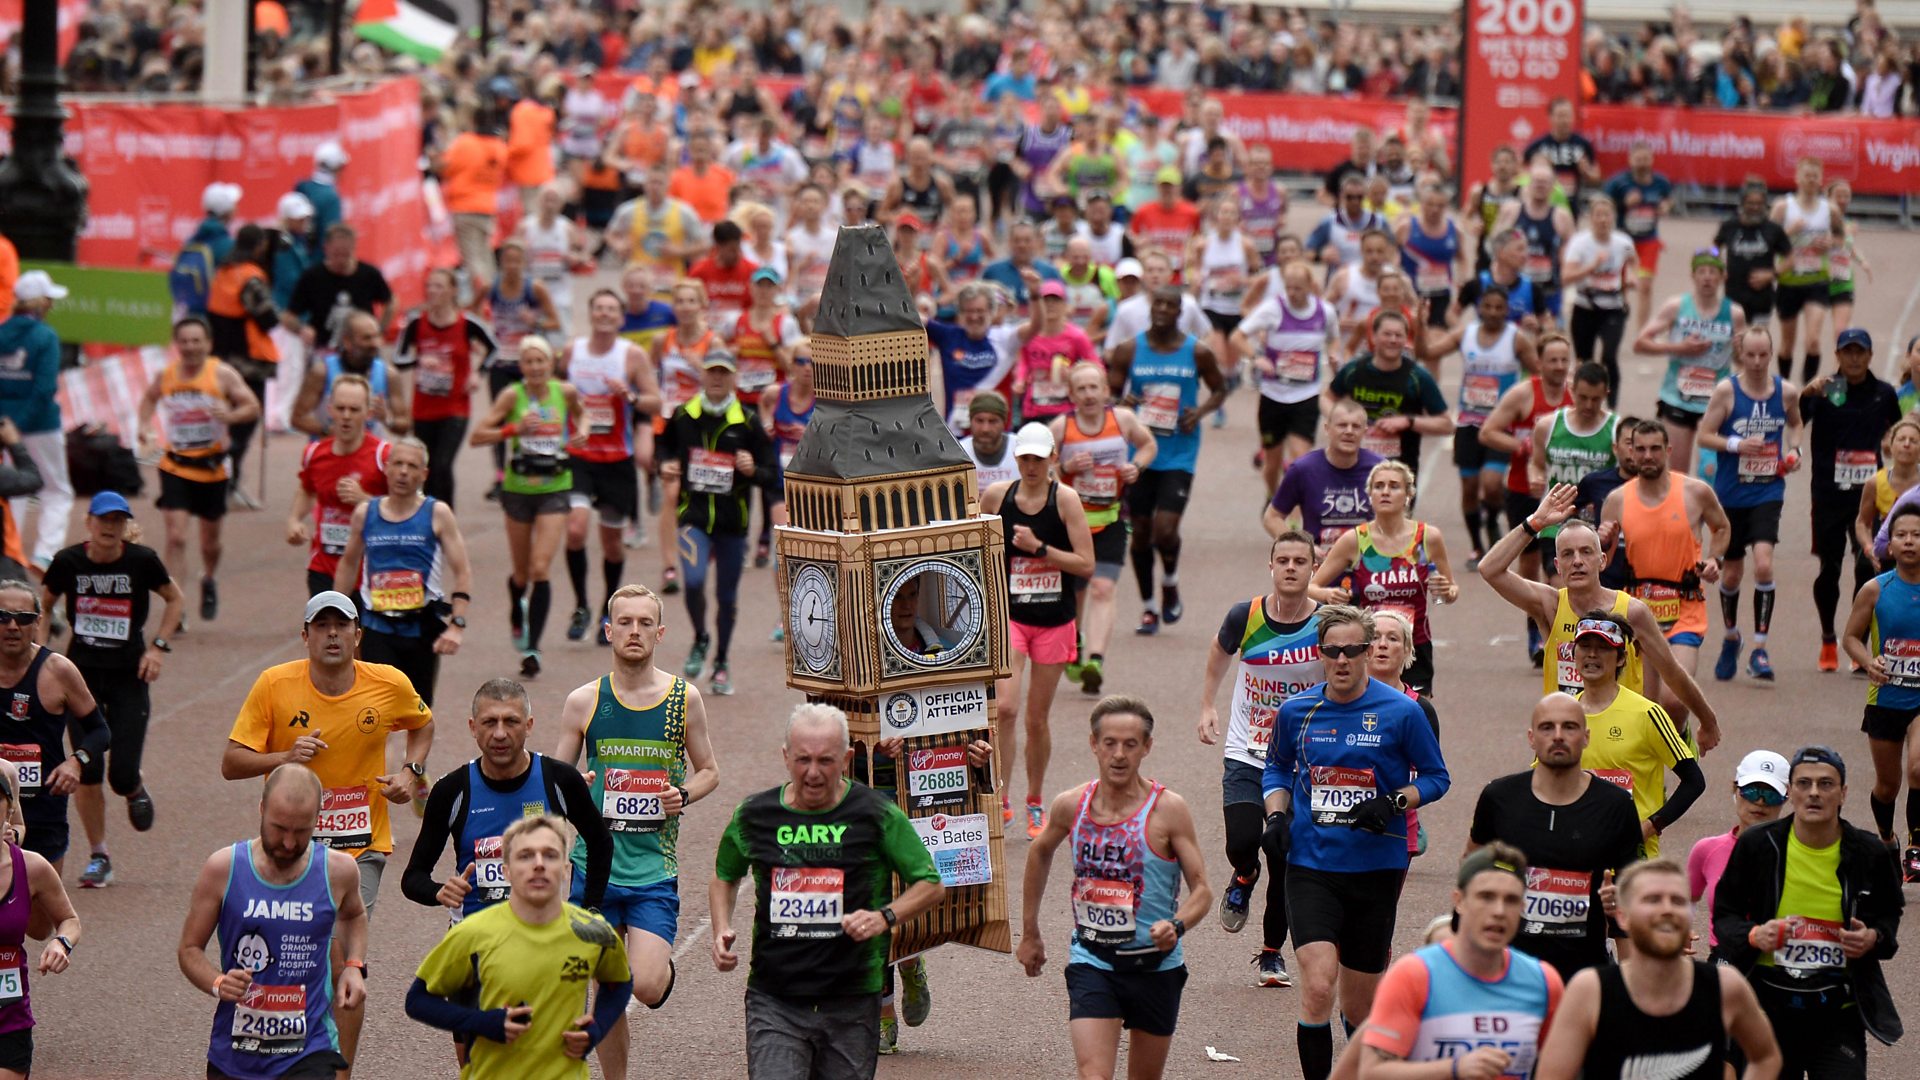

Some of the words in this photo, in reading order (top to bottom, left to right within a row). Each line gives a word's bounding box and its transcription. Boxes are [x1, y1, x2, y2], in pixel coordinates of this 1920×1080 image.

[1475, 0, 1575, 35] 200
[1489, 58, 1520, 79] TO
[1523, 59, 1560, 80] GO
[1267, 114, 1353, 144] Maratho
[1669, 128, 1766, 160] Marathon
[1353, 386, 1403, 408] Harry
[1751, 401, 1771, 419] AL
[977, 469, 1011, 479] WISTY
[76, 574, 132, 594] PWR
[1016, 574, 1060, 590] 34707
[1370, 569, 1419, 585] CIARA
[1365, 586, 1417, 598] mencap
[1650, 602, 1679, 618] 909
[82, 616, 126, 636] 28516
[1268, 645, 1317, 665] PAUL
[1244, 671, 1315, 695] RAINBOW
[925, 689, 982, 706] OFFICIAL
[926, 701, 983, 719] ATTEMPT
[1356, 733, 1382, 743] TJALVE
[600, 745, 673, 759] SAMARITANS
[935, 751, 964, 761] money
[633, 777, 665, 787] money
[918, 770, 965, 791] 26885
[1339, 773, 1372, 783] money
[335, 791, 366, 802] money
[616, 796, 660, 816] 6823
[314, 811, 368, 832] 44328
[776, 824, 847, 845] GARY
[921, 834, 938, 847] as
[943, 828, 983, 844] Bates
[1081, 842, 1127, 864] ALEX
[803, 875, 841, 887] money
[1552, 876, 1590, 889] money
[1095, 886, 1132, 900] money
[243, 898, 314, 922] JAMES
[779, 898, 838, 918] 23441
[1087, 905, 1128, 927] 6263
[1526, 895, 1588, 919] 70699
[281, 934, 311, 944] GREAT
[1808, 923, 1841, 937] mone
[280, 943, 318, 951] ORMOND
[280, 952, 311, 960] STREET
[1784, 944, 1844, 966] 72363
[0, 951, 17, 962] ney
[267, 992, 304, 1004] money
[242, 1013, 305, 1037] 24880
[1474, 1015, 1509, 1034] ED
